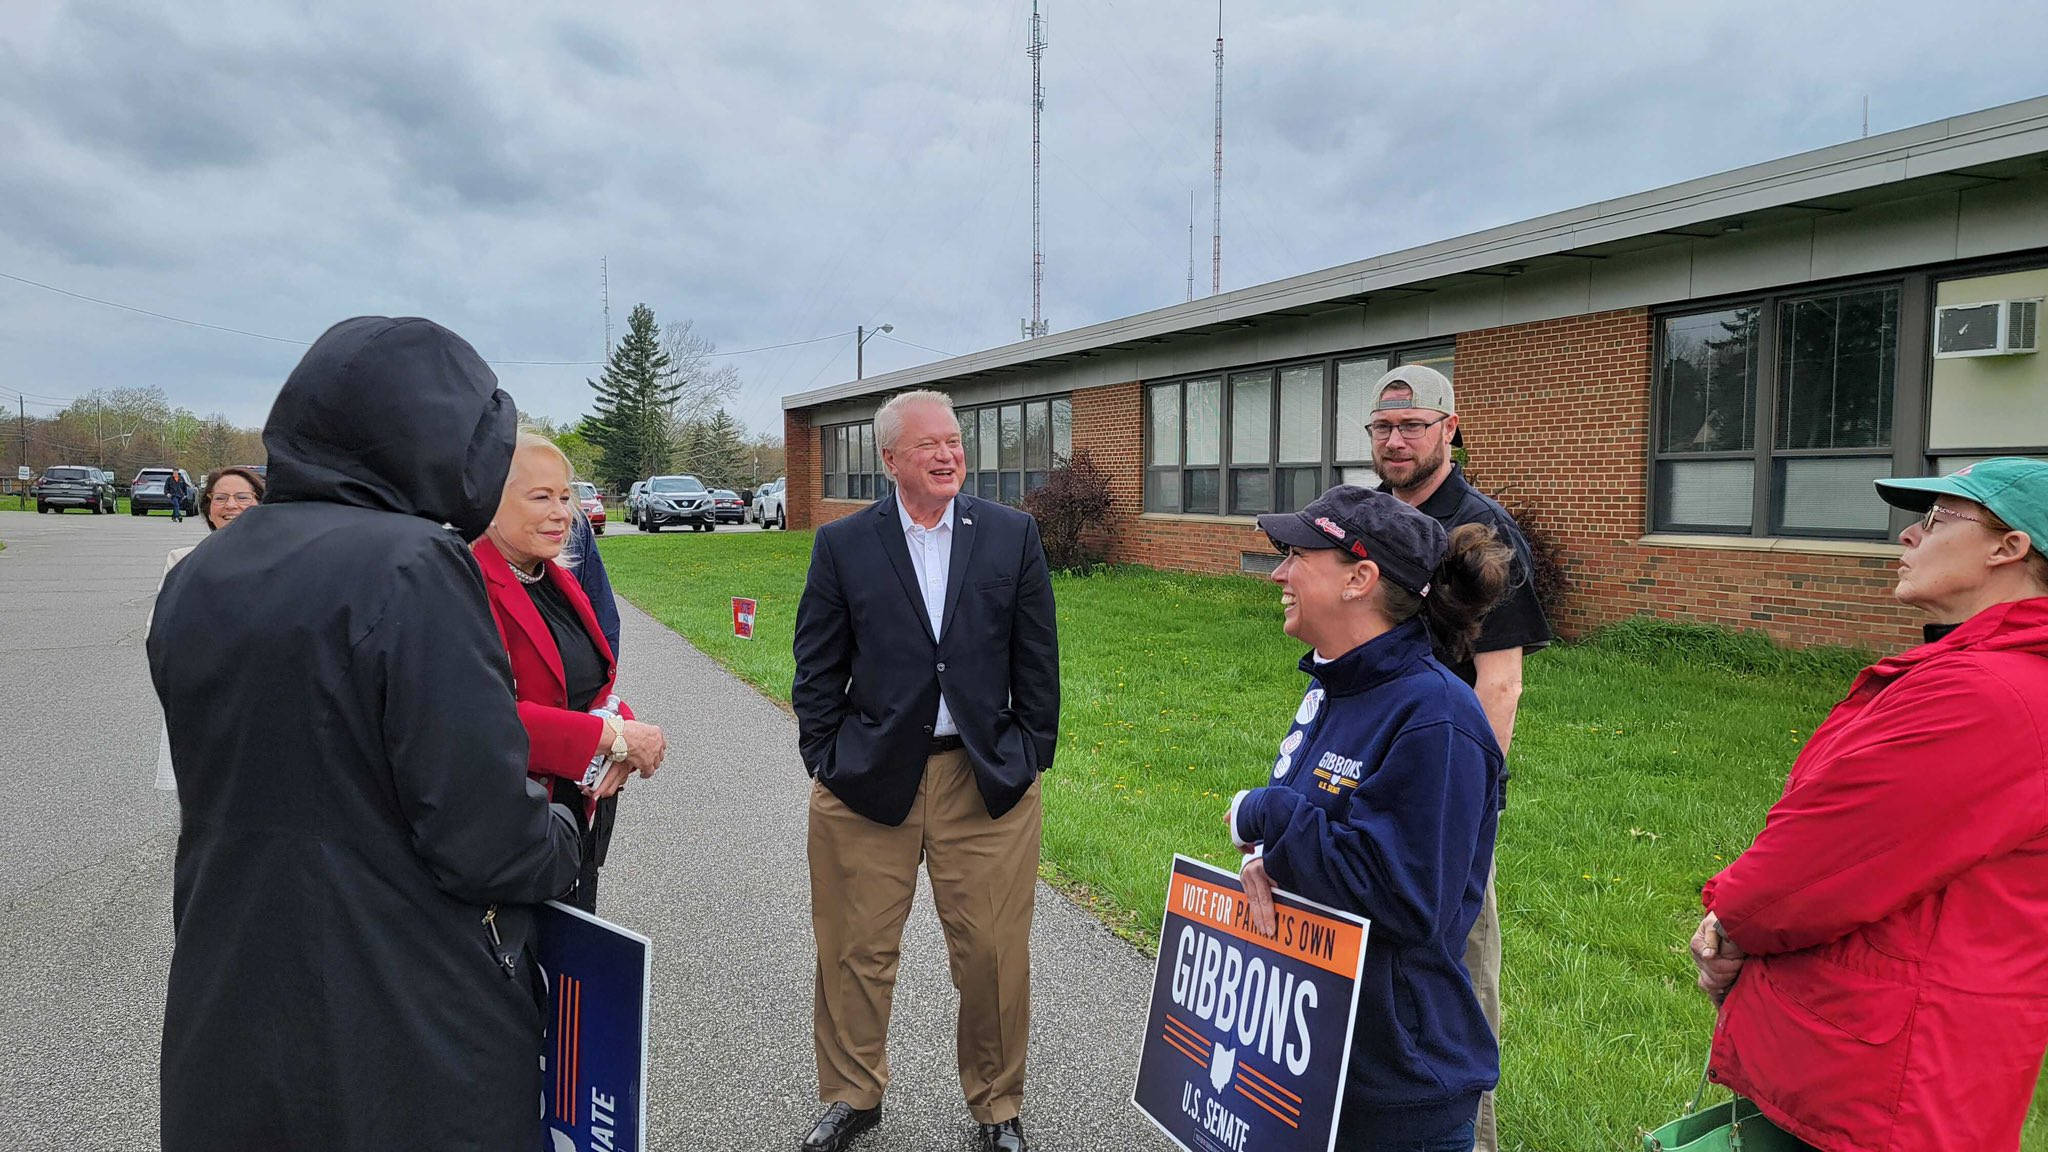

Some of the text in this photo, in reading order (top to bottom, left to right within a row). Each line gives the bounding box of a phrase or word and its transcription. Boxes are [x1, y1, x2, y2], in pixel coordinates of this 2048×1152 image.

[1318, 751, 1363, 779] GIBBONS
[1181, 882, 1208, 917] VOTE
[1209, 892, 1233, 926] FOR
[1299, 920, 1336, 961] OWN
[1171, 924, 1318, 1077] GIBBONS
[1182, 1080, 1250, 1152] U.S. SENATE
